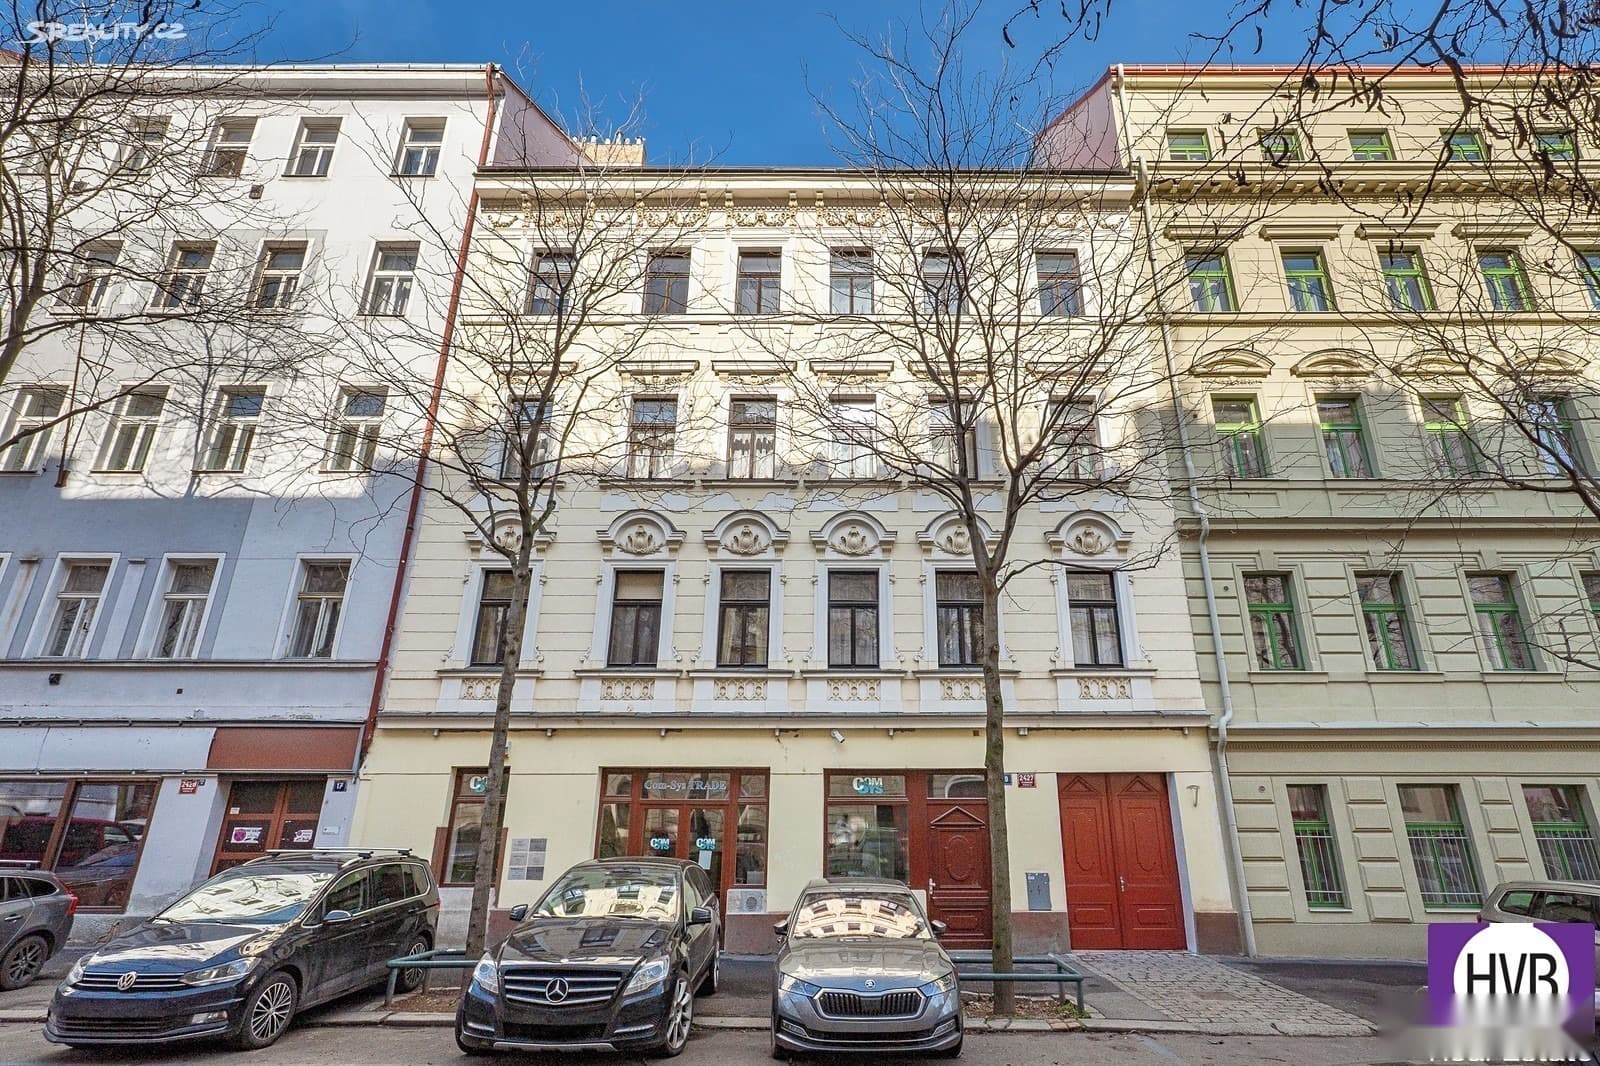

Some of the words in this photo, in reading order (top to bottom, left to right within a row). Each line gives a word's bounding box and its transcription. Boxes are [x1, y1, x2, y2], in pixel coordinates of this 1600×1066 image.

[336, 782, 344, 790] 17
[689, 780, 727, 790] TRADE
[853, 777, 883, 790] COM
